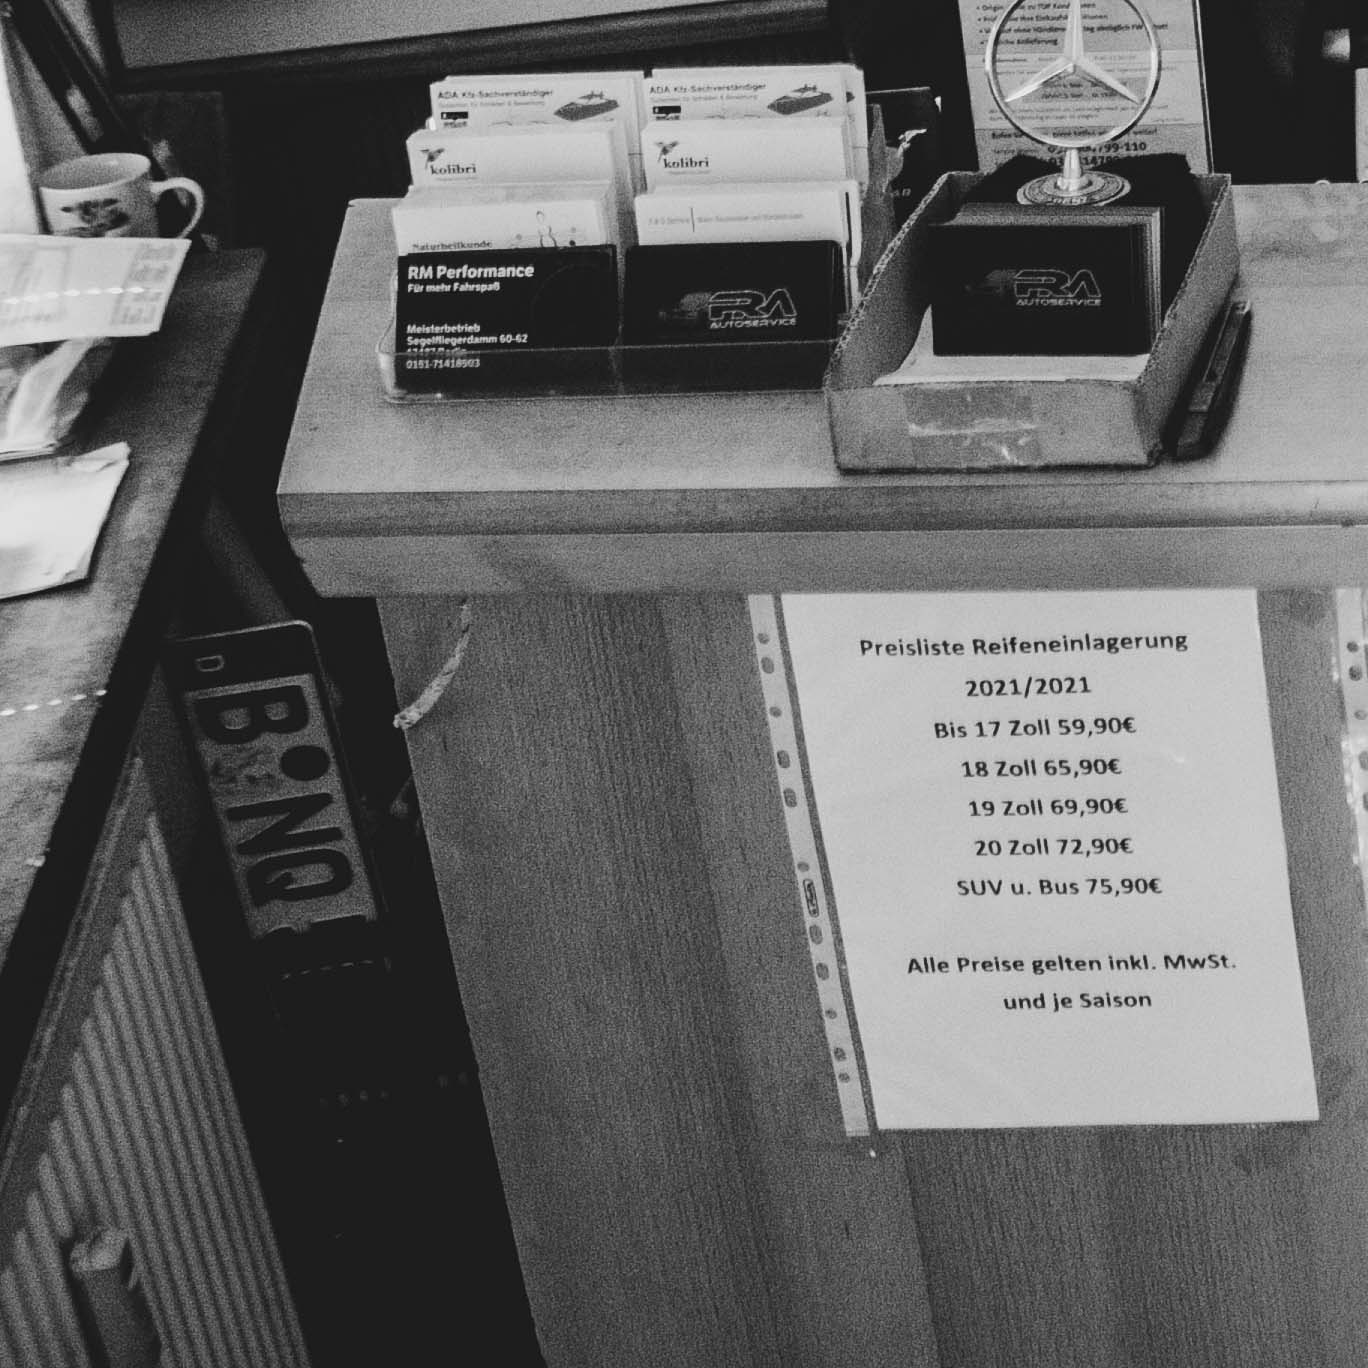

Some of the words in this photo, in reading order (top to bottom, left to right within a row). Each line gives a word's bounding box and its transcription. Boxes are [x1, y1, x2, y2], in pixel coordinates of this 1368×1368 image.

[430, 163, 478, 176] kolibri
[662, 156, 710, 169] kolibri
[407, 265, 434, 280] RM
[436, 264, 535, 280] Performance
[407, 283, 425, 294] Für
[425, 283, 451, 293] mehr
[453, 281, 501, 294] Fahrspaß
[1015, 298, 1102, 307] AUTOSERVICE
[406, 323, 481, 335] Meisterbetrieb
[710, 317, 797, 329] AUTOSERVICE
[406, 334, 498, 347] Segelfliegerdamm
[860, 637, 965, 657] Preisliste
[972, 632, 1188, 656] Reifeneinlagerung
[195, 654, 227, 673] D
[965, 675, 1092, 699] 2021/2021
[196, 684, 310, 745] B
[934, 720, 968, 739] Bis
[975, 720, 1001, 738] 17
[1008, 718, 1051, 738] Zoll
[1058, 715, 1137, 738] 59,90€
[961, 760, 989, 779] 18
[995, 758, 1038, 778] Zoll
[1044, 757, 1122, 779] 65,90€
[968, 800, 996, 817] 19
[1002, 798, 1044, 817] Zoll
[1050, 796, 1129, 818] 69,90€
[974, 839, 1002, 857] 20
[1008, 837, 1050, 857] Zoll
[1056, 836, 1134, 858] 72,90€
[956, 878, 1003, 897] SUV
[1010, 882, 1032, 896] u.
[1038, 878, 1080, 896] Bus
[1086, 877, 1163, 898] 75,90€
[907, 955, 950, 974] Alle
[956, 956, 1025, 973] Preise
[1031, 955, 1103, 976] gelten
[1108, 954, 1157, 972] inkl.
[1162, 953, 1237, 972] MwSt.
[1003, 993, 1046, 1011] und
[1052, 993, 1074, 1012] je
[1079, 991, 1153, 1010] Saison
